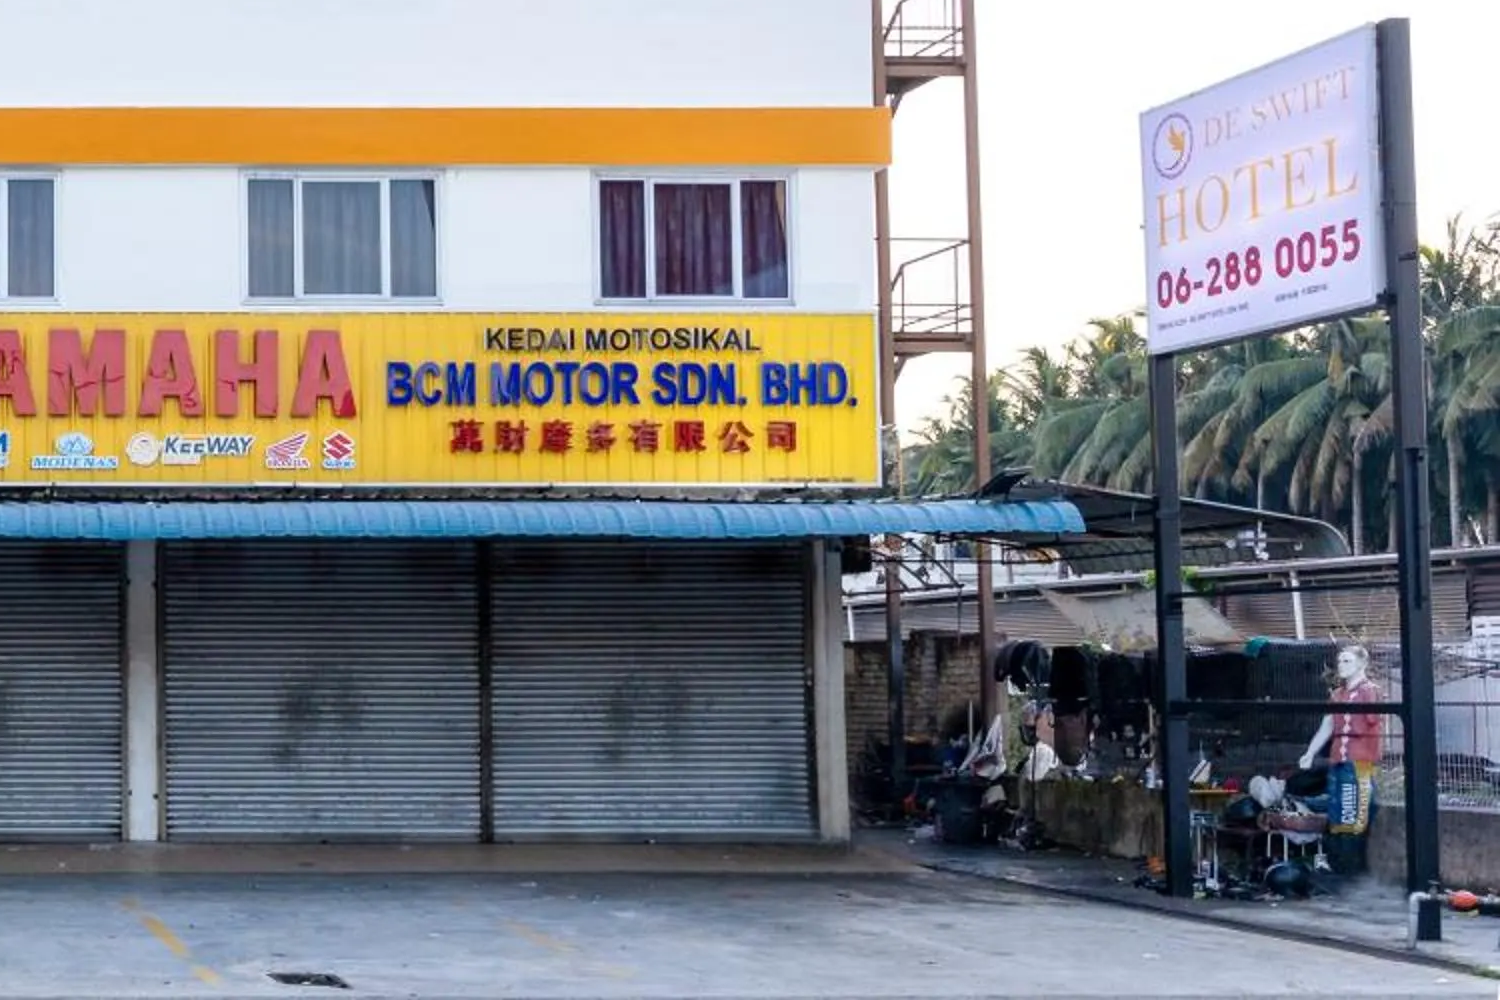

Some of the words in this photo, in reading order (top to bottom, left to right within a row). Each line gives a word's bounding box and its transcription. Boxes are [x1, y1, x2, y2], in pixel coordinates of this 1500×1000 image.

[1204, 110, 1245, 148] DE
[1252, 67, 1356, 131] SWIFT
[1157, 138, 1358, 246] HOTEL
[1157, 246, 1263, 309] 06-288
[1274, 218, 1361, 279] 0055
[485, 328, 576, 351] KEDAI
[585, 327, 762, 352] MOTOSIKAL
[386, 361, 476, 407] BCM
[490, 361, 640, 407] MOTOR
[651, 361, 748, 407] SDN.
[760, 361, 858, 407] BHD.
[33, 457, 118, 468] MODENAS
